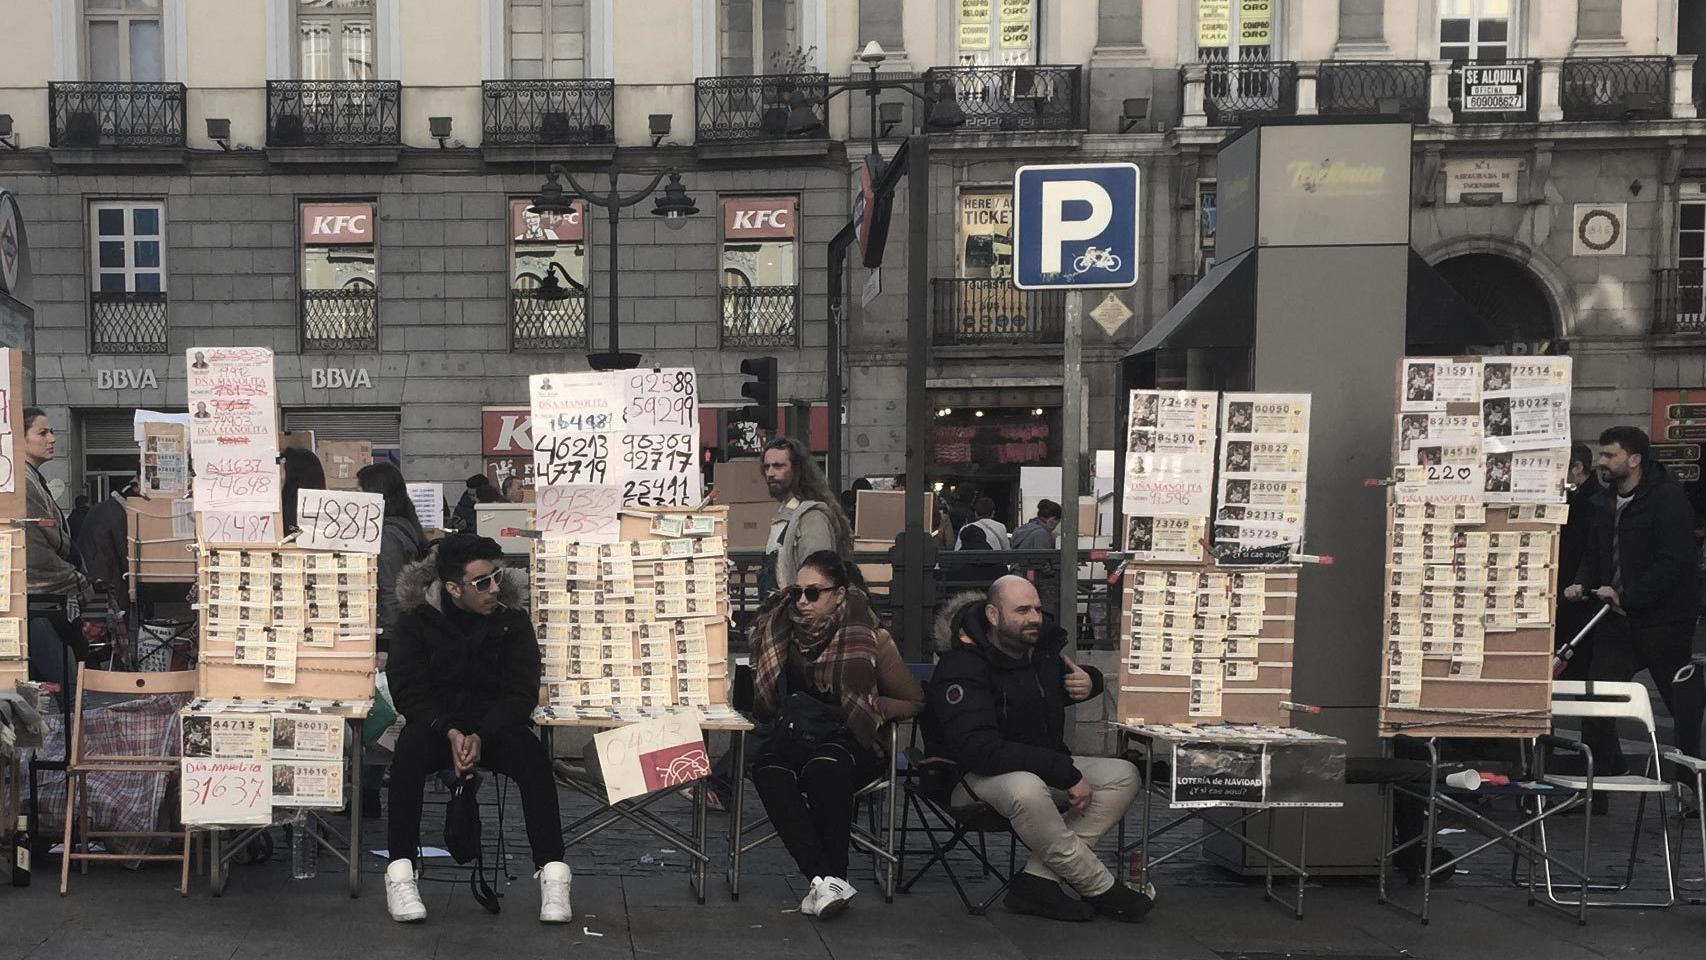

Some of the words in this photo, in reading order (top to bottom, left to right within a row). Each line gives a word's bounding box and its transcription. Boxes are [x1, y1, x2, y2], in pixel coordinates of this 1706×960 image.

[1466, 70, 1479, 84] SE
[1482, 69, 1522, 85] ALQUILA
[964, 199, 991, 209] HERE
[311, 215, 367, 235] KFC
[732, 209, 788, 229] KFC
[1041, 180, 1113, 274] P
[97, 368, 159, 390] BBVA
[311, 368, 373, 389] BBVA
[1512, 367, 1551, 375] 77514
[630, 371, 694, 396] 92588
[535, 434, 609, 466] 46213
[1241, 529, 1279, 538] 55729
[213, 720, 255, 730] 44713
[1178, 776, 1210, 785] LOTERÍA
[1224, 778, 1263, 787] NAVIDAD
[185, 776, 265, 809] 31637
